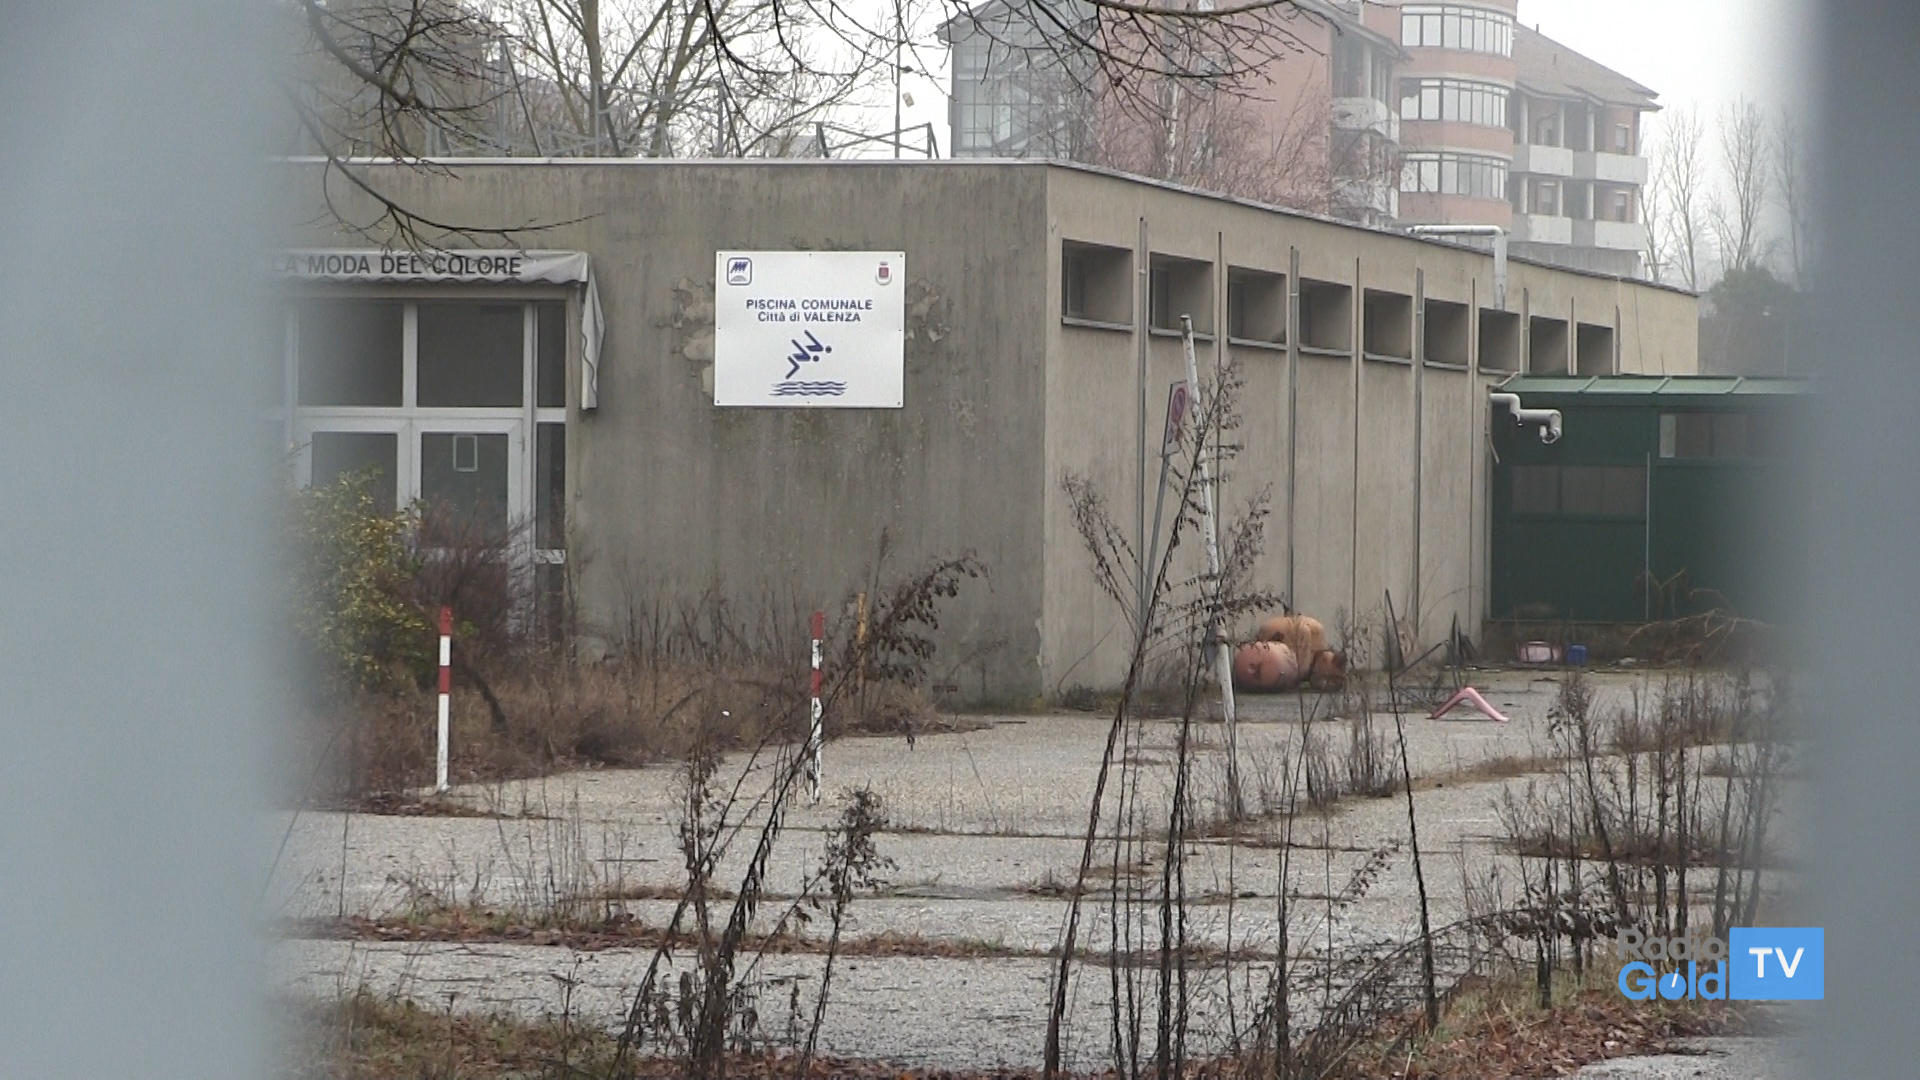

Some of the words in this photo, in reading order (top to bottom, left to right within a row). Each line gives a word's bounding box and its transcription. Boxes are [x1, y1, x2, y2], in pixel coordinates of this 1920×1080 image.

[308, 255, 371, 275] MODA
[380, 254, 420, 275] DEL
[432, 254, 523, 275] COLORE
[746, 299, 797, 310] PISCINA
[801, 299, 873, 310] COMUNALE
[757, 311, 786, 322] Città
[789, 311, 800, 322] di
[804, 312, 861, 322] VALENZA
